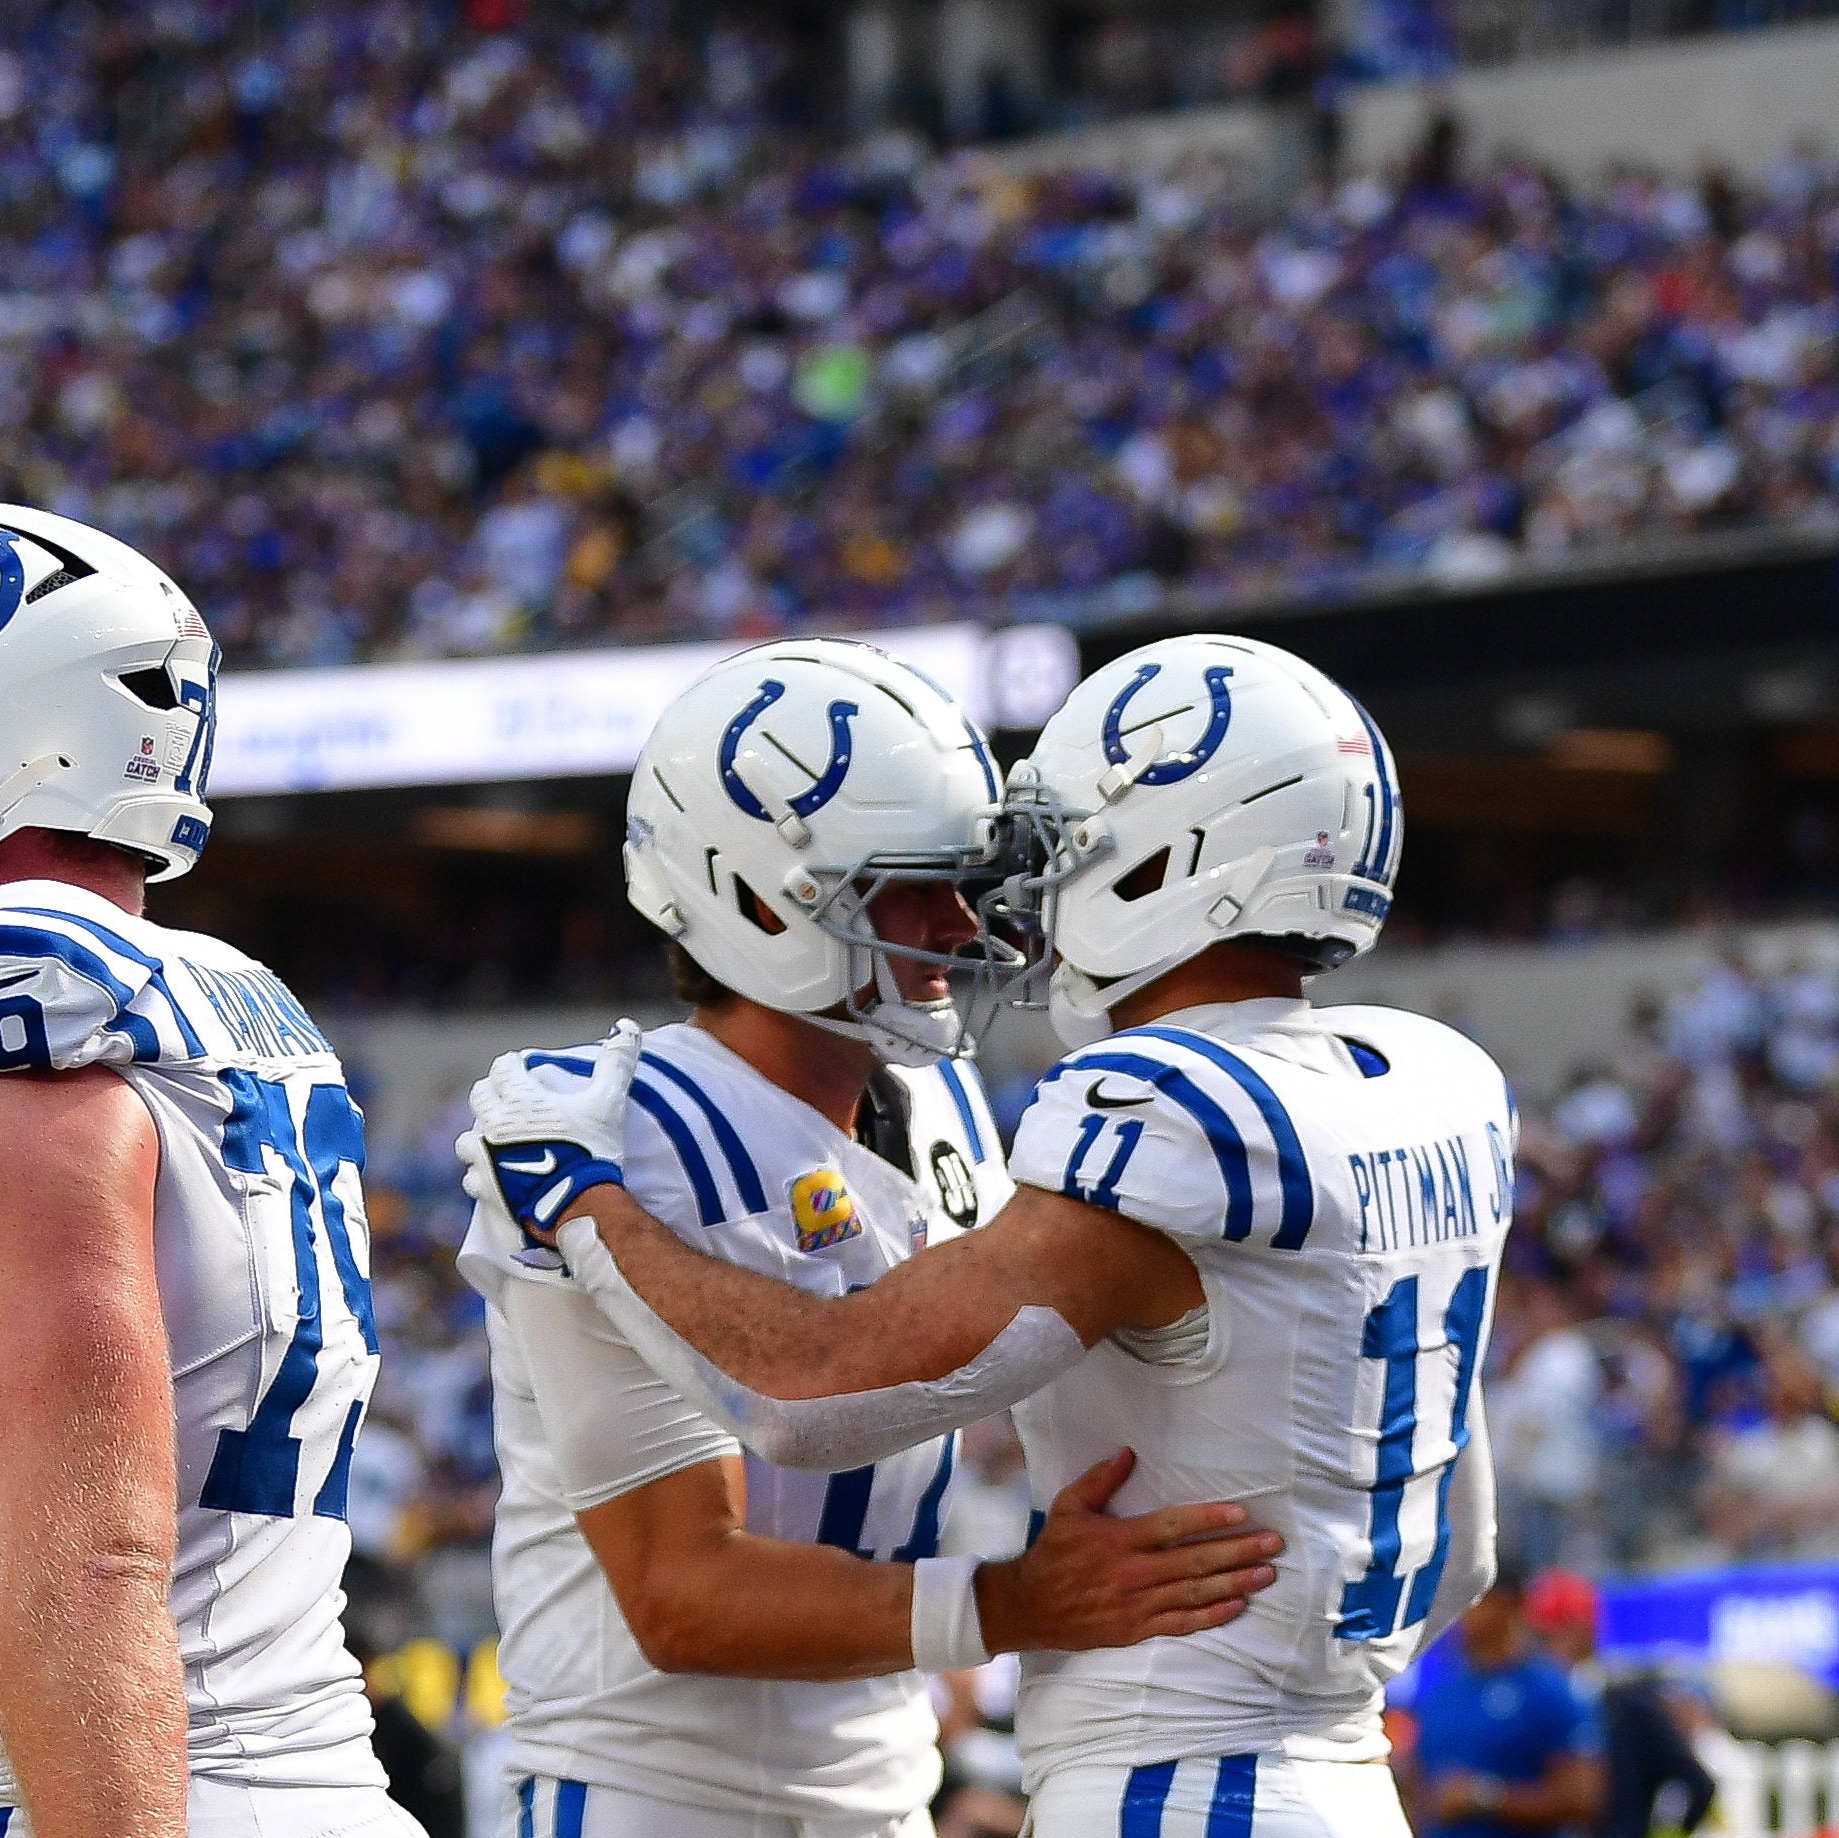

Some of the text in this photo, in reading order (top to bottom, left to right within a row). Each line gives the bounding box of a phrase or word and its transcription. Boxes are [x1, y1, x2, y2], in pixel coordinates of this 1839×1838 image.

[125, 761, 161, 779] CATCH
[791, 1168, 853, 1234] C
[1061, 1113, 1145, 1212] 11
[1348, 1135, 1478, 1252] PITTMAN
[1333, 1264, 1490, 1640] 11
